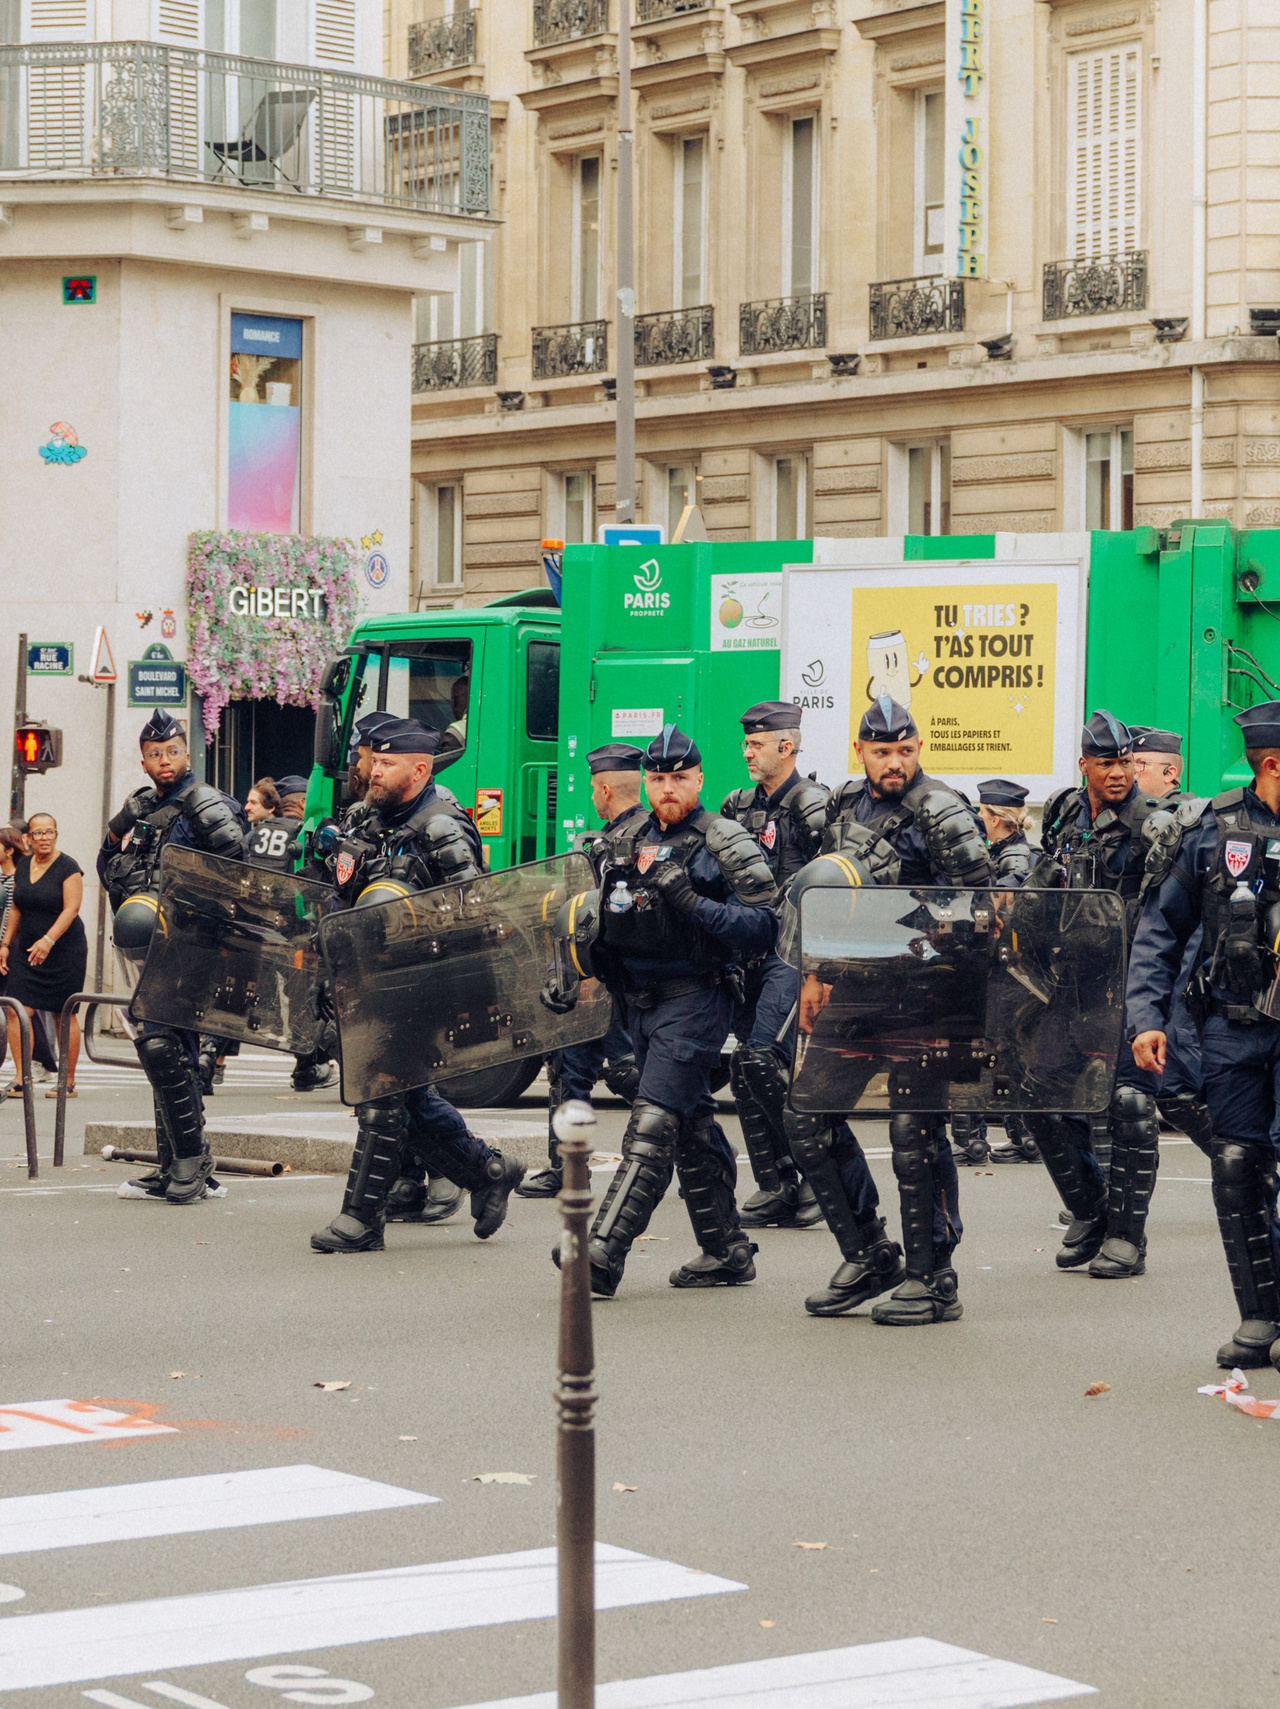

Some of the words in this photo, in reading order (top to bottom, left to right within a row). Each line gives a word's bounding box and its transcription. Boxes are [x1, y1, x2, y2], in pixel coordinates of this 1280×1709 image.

[957, 117, 985, 279] JOSEPH
[243, 328, 280, 343] ROMANCE
[624, 592, 671, 609] PARIS
[934, 605, 958, 627] TU
[962, 603, 1017, 627] TRIES
[1020, 603, 1030, 626] ?
[722, 639, 732, 649] AU
[733, 638, 746, 648] GAZ
[747, 637, 778, 648] NATUREL
[934, 635, 974, 658] T'AS
[978, 634, 1034, 658] TOUT
[40, 654, 57, 662] RUE
[34, 662, 64, 670] RACINE
[138, 671, 177, 682] BOULEVARD
[933, 665, 1034, 689] COMPRIS
[1037, 664, 1044, 688] !
[135, 687, 154, 697] SAINT
[155, 687, 180, 697] MICHEL
[793, 696, 835, 708] PARIS
[930, 715, 936, 726] À
[937, 717, 960, 727] PARIS,
[930, 730, 949, 739] TOUS
[950, 730, 962, 739] LES
[962, 730, 993, 739] PAPIERS
[993, 730, 1001, 739] ET
[930, 743, 976, 752] EMBALLAGES
[977, 743, 985, 752] SE
[986, 742, 1012, 752] TRIENT.
[254, 827, 289, 857] 3B
[1228, 852, 1248, 862] CRS
